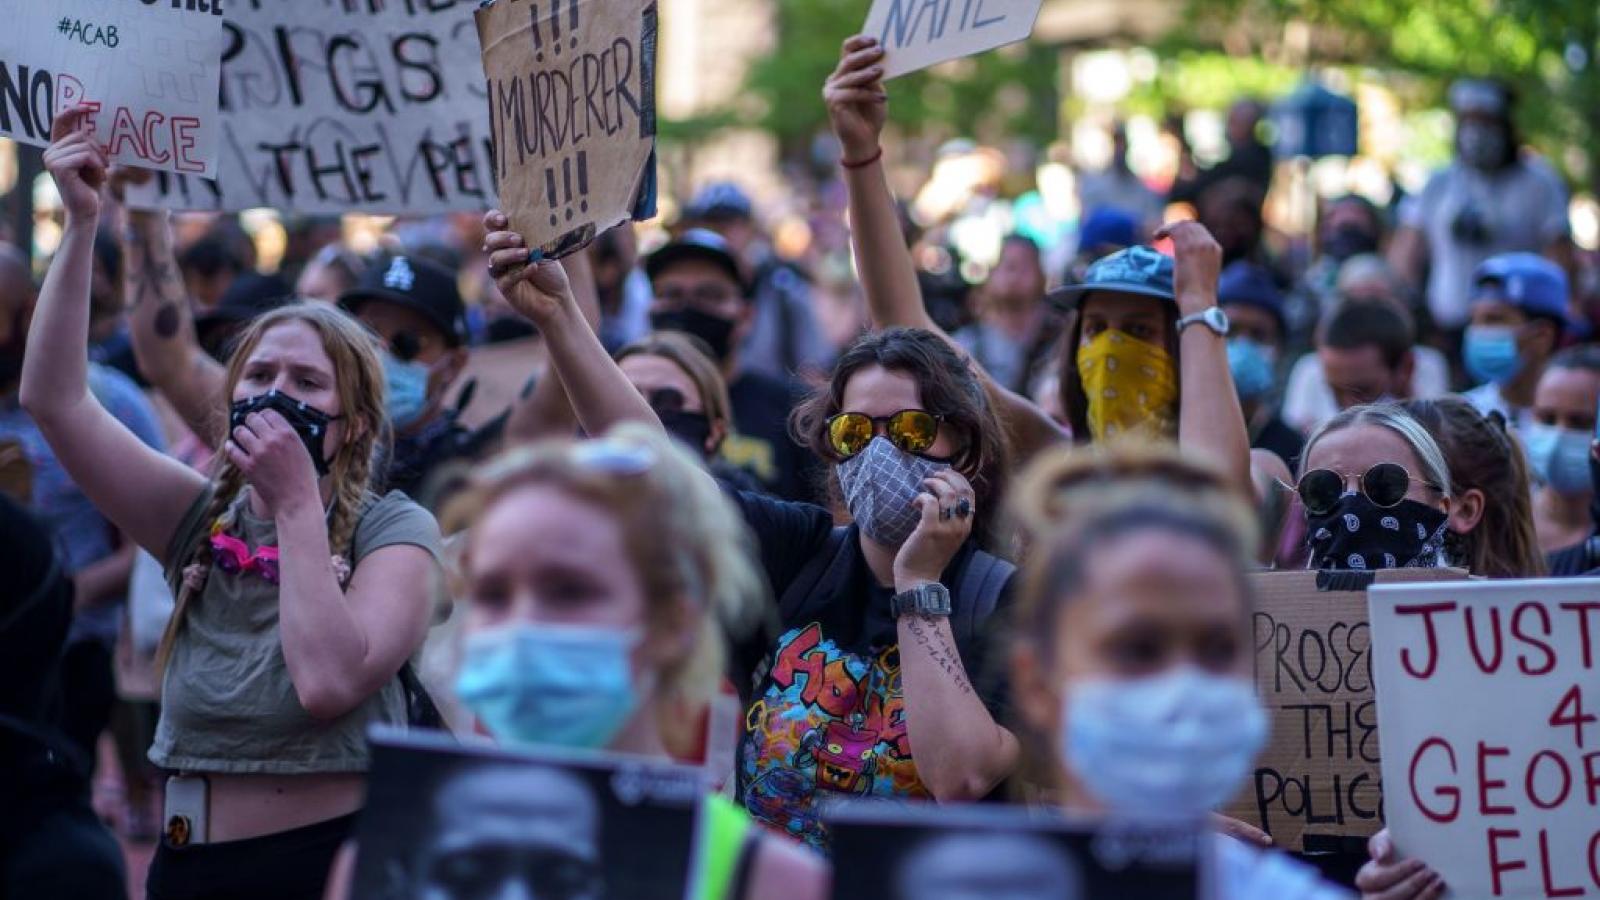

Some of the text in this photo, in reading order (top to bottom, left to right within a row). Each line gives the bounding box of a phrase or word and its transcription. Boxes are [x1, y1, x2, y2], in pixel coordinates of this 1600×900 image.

[57, 16, 120, 48] #ACAB
[218, 20, 443, 113] PIGS
[0, 61, 53, 141] NO
[258, 136, 386, 202] THE
[1252, 612, 1376, 697] PROSE
[1394, 601, 1600, 680] JUST
[1281, 701, 1381, 763] THE
[1549, 684, 1598, 749] 4
